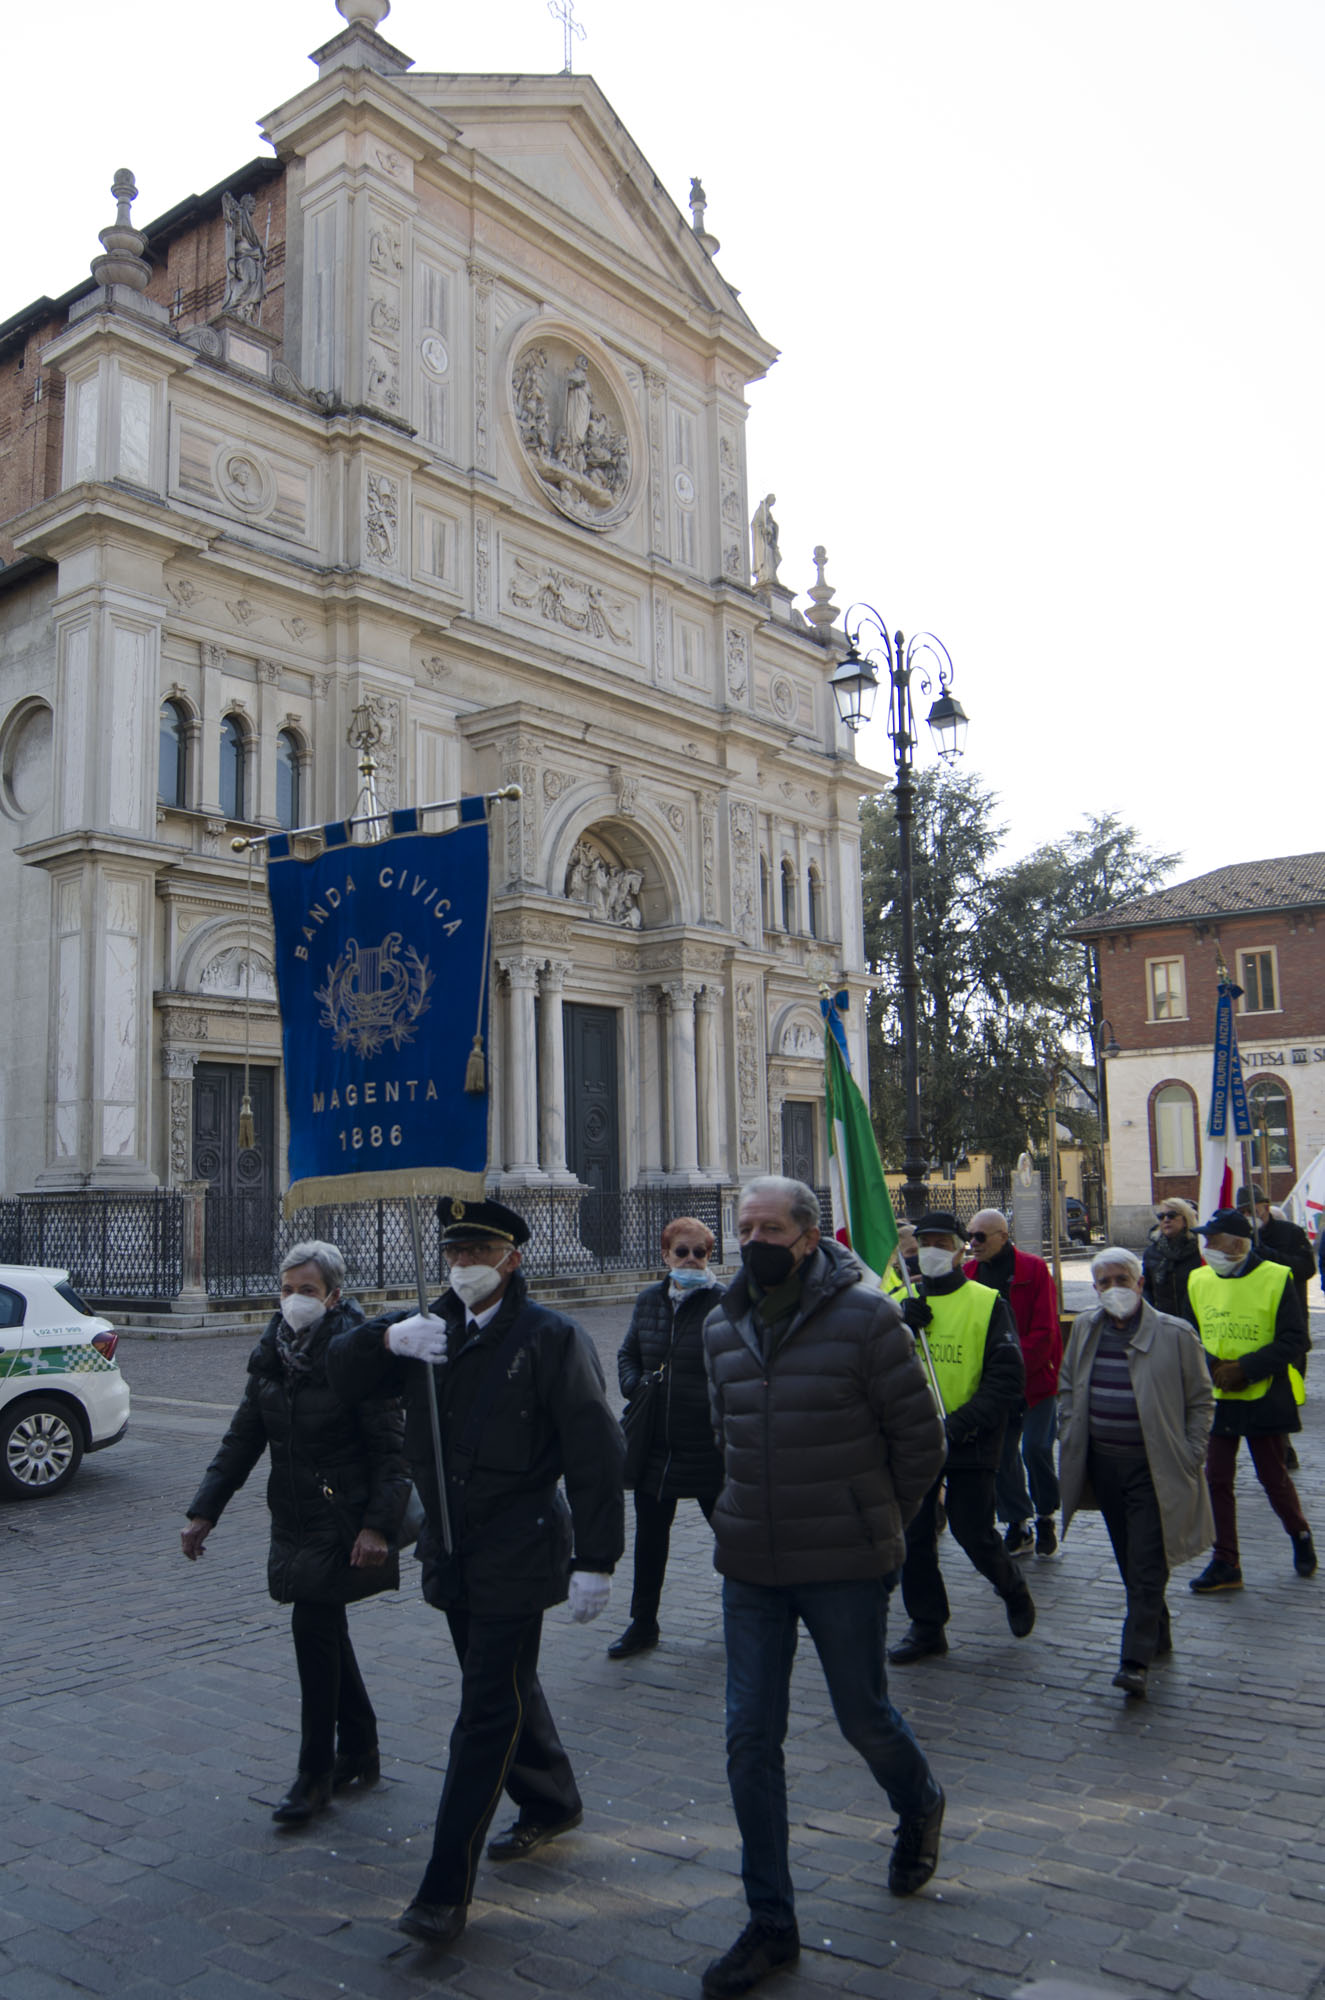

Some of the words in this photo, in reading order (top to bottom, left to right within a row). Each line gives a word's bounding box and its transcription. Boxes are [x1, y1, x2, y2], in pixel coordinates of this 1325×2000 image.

[294, 874, 356, 961] BANDA
[379, 867, 464, 938] CIVICA
[1219, 1007, 1230, 1046] ANZIANI
[1216, 1050, 1228, 1087] DIURNO
[1240, 1051, 1285, 1066] NTESA
[312, 1079, 438, 1113] MAGENTA
[1213, 1091, 1225, 1130] CENTRO
[1231, 1056, 1249, 1130] MAGENTA
[338, 1124, 402, 1151] 1886
